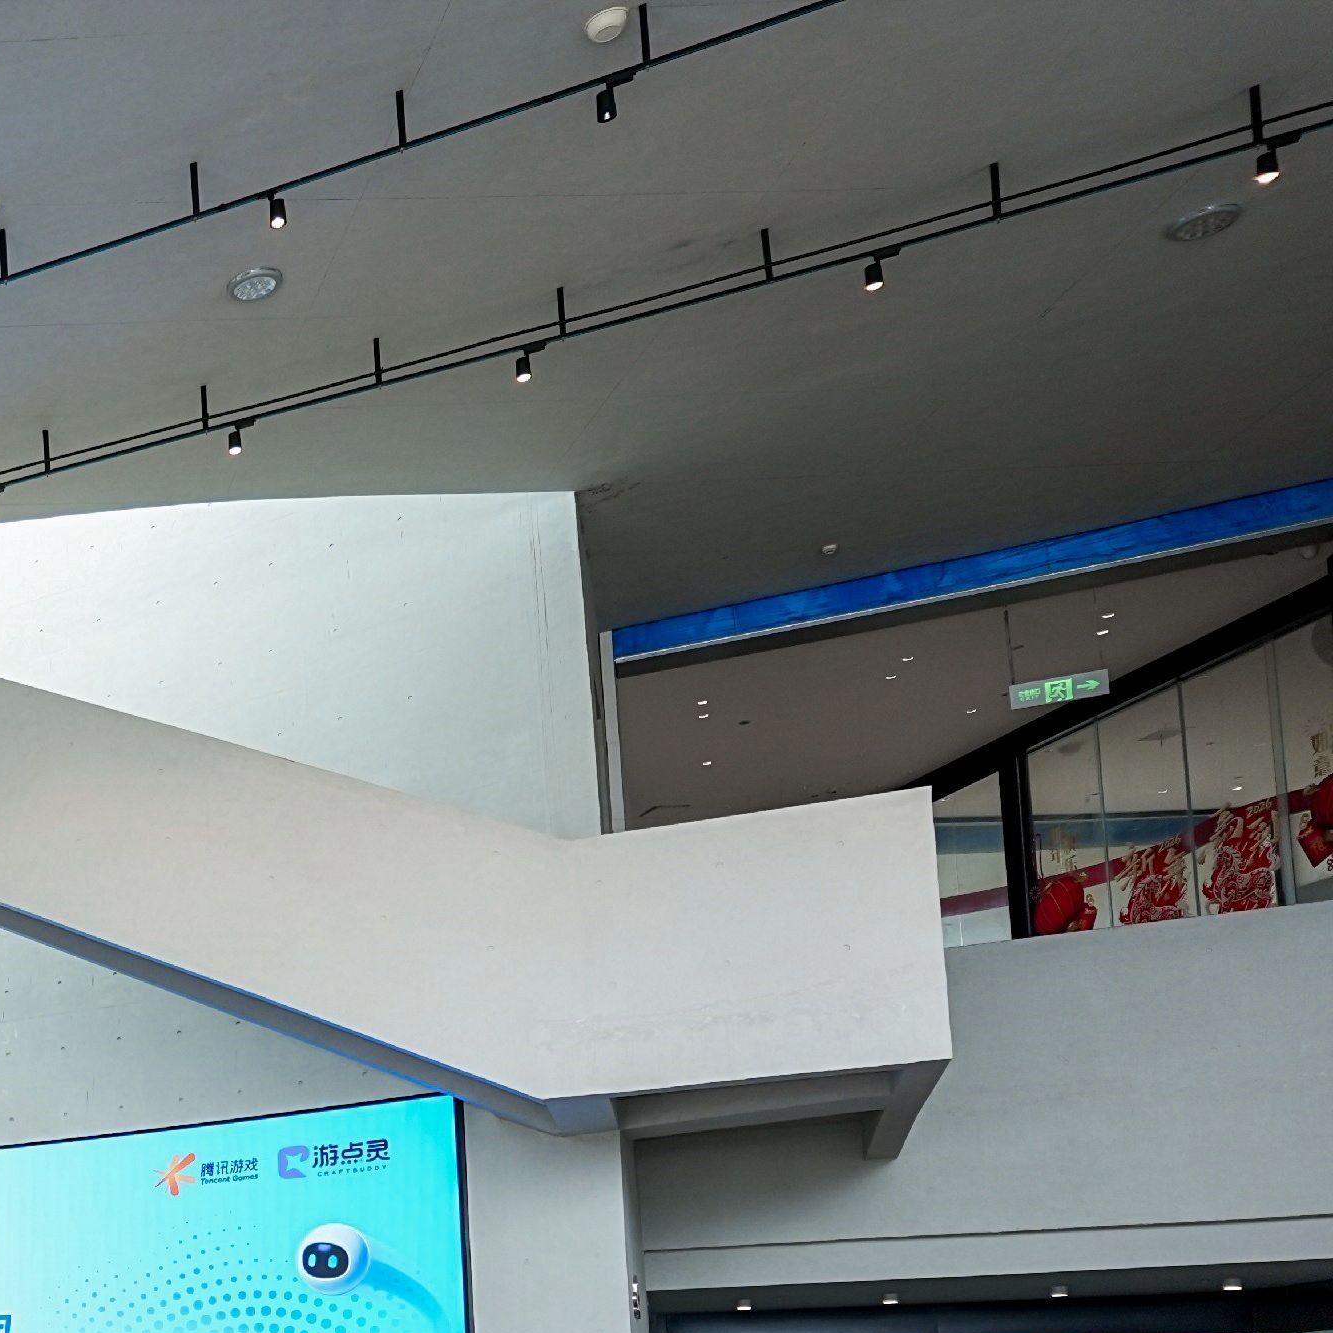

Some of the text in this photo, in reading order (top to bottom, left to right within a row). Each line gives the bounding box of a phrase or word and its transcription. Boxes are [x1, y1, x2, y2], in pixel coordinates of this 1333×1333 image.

[311, 1139, 390, 1168] 游点灵
[200, 1158, 259, 1177] 腾讯游戏
[200, 1173, 259, 1185] Tencent Games
